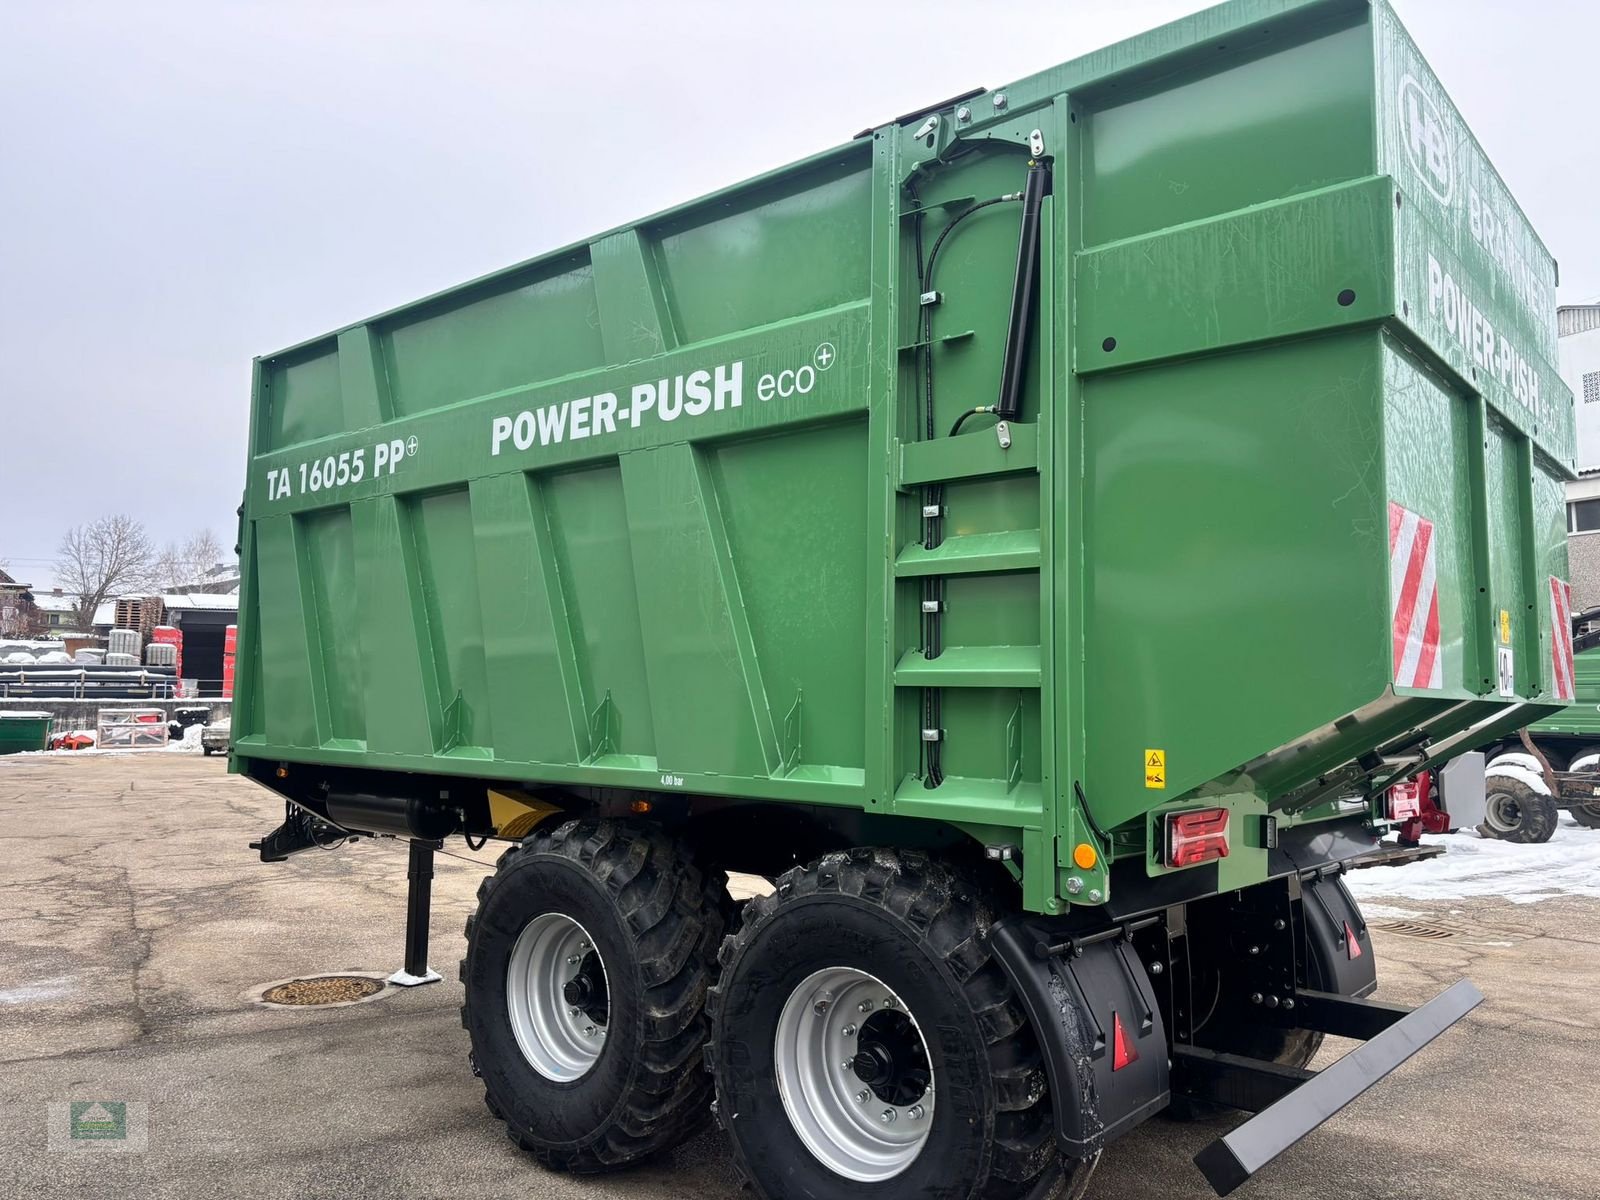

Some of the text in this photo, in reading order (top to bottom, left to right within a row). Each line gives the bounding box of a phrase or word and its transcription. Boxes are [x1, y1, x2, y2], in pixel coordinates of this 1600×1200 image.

[1428, 252, 1539, 417] POWER-PUSH
[491, 360, 743, 457] POWER-PUSH
[267, 467, 292, 501] TA
[299, 448, 364, 494] 16055
[673, 775, 684, 786] bar
